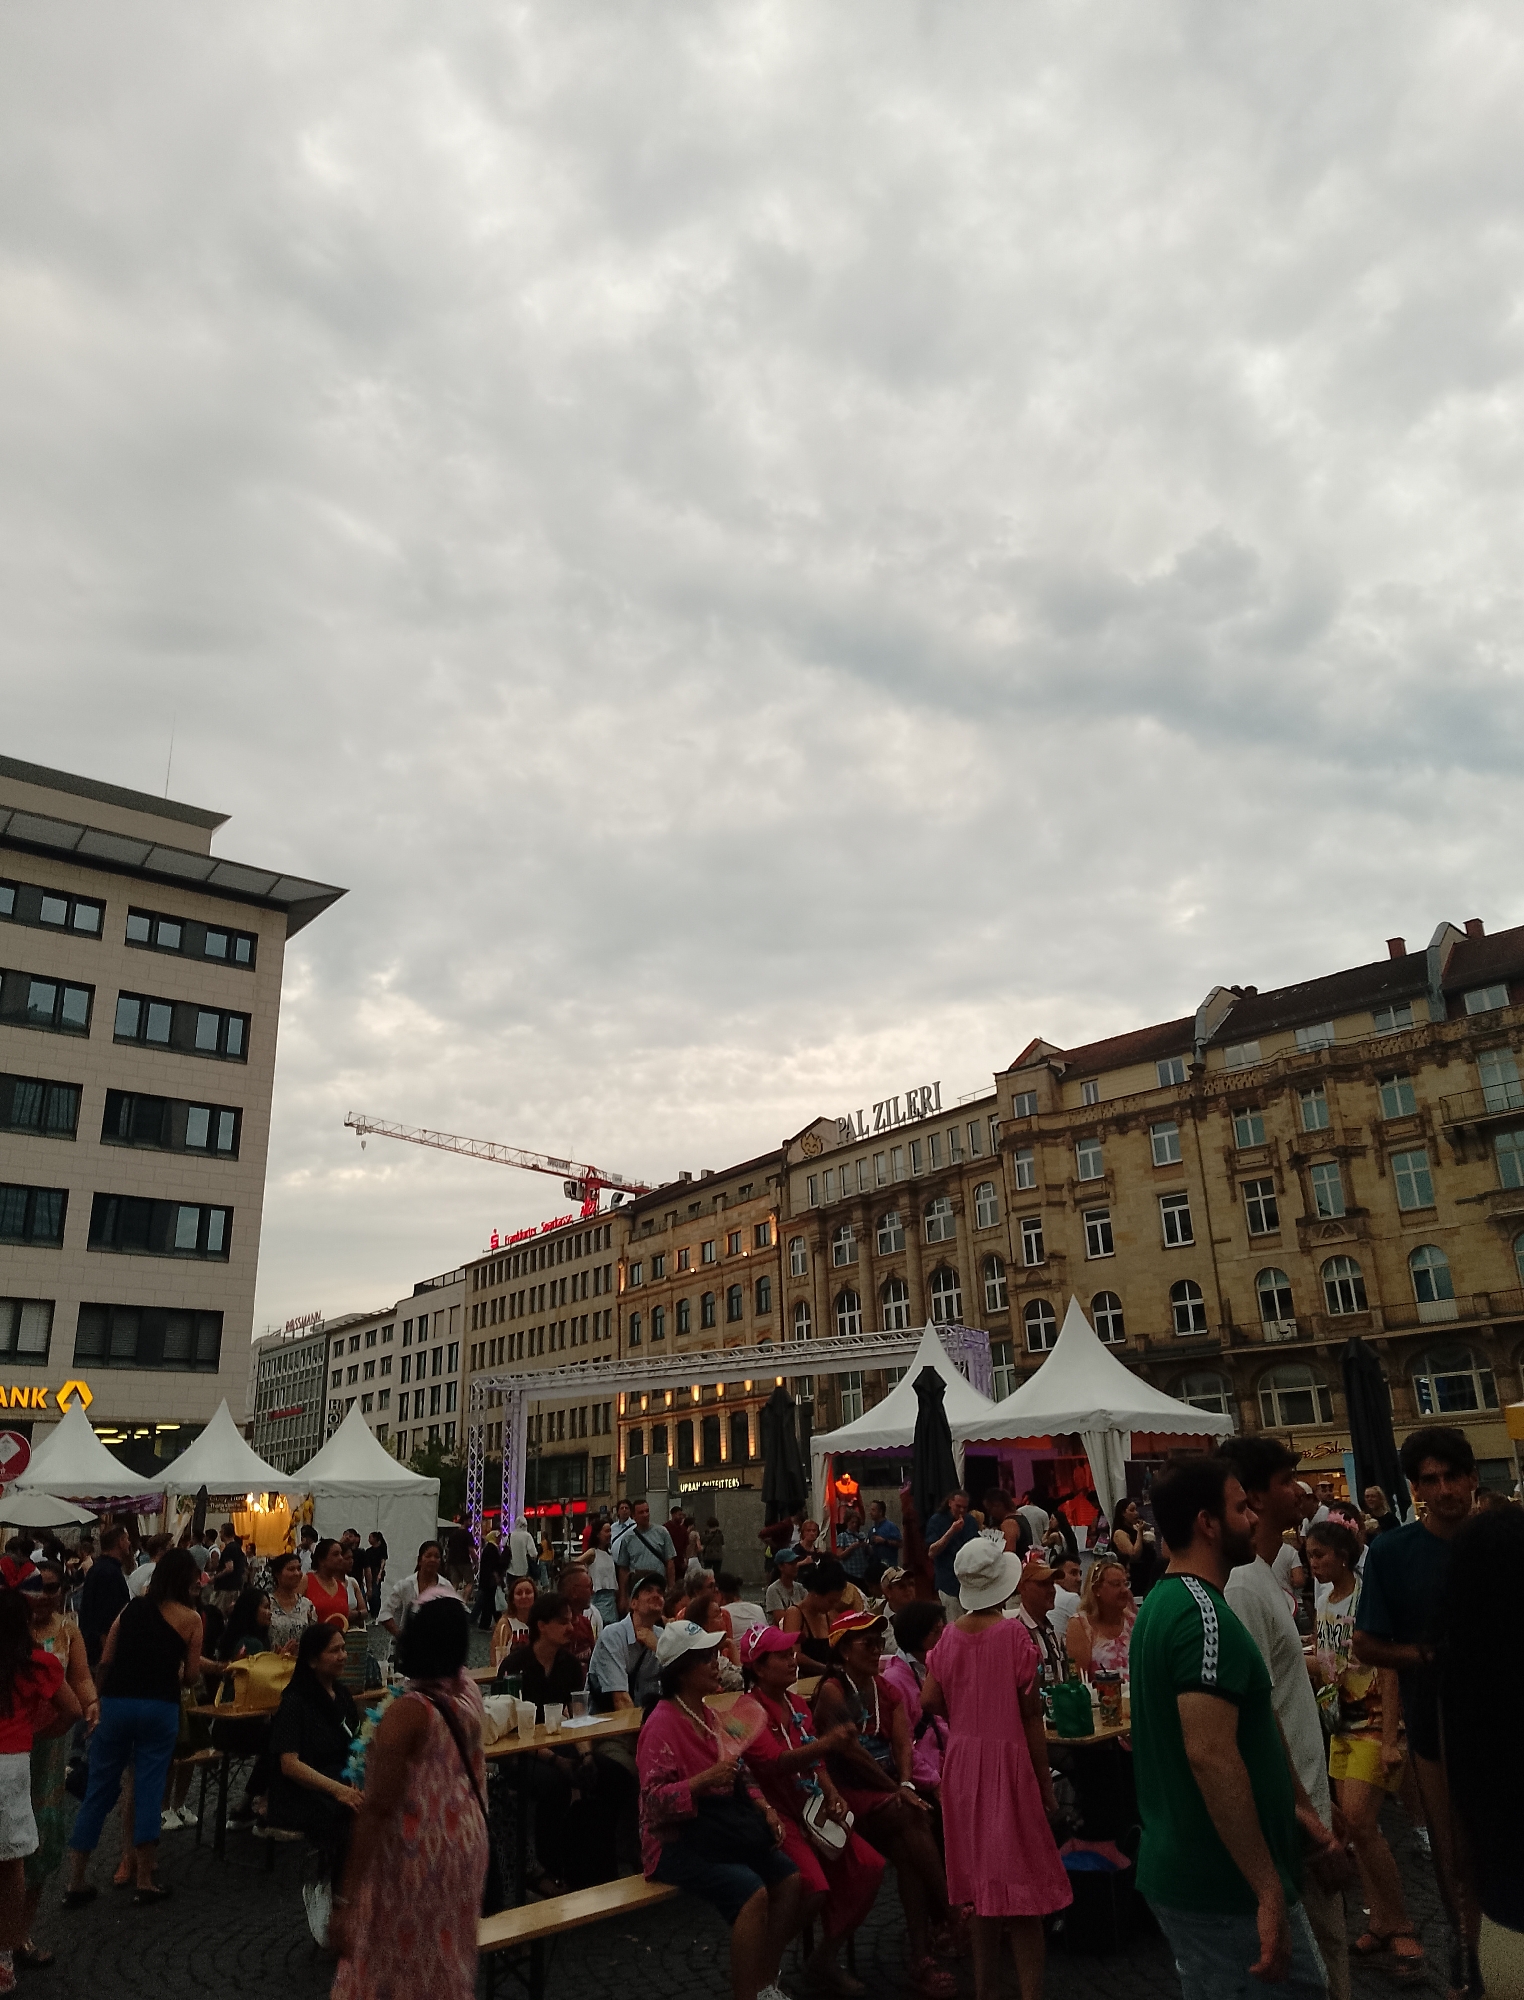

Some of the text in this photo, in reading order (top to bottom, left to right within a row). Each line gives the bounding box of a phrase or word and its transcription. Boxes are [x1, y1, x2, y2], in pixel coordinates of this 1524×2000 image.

[834, 1081, 943, 1146] PAL ZILERI
[285, 1309, 322, 1333] ROSSMANN
